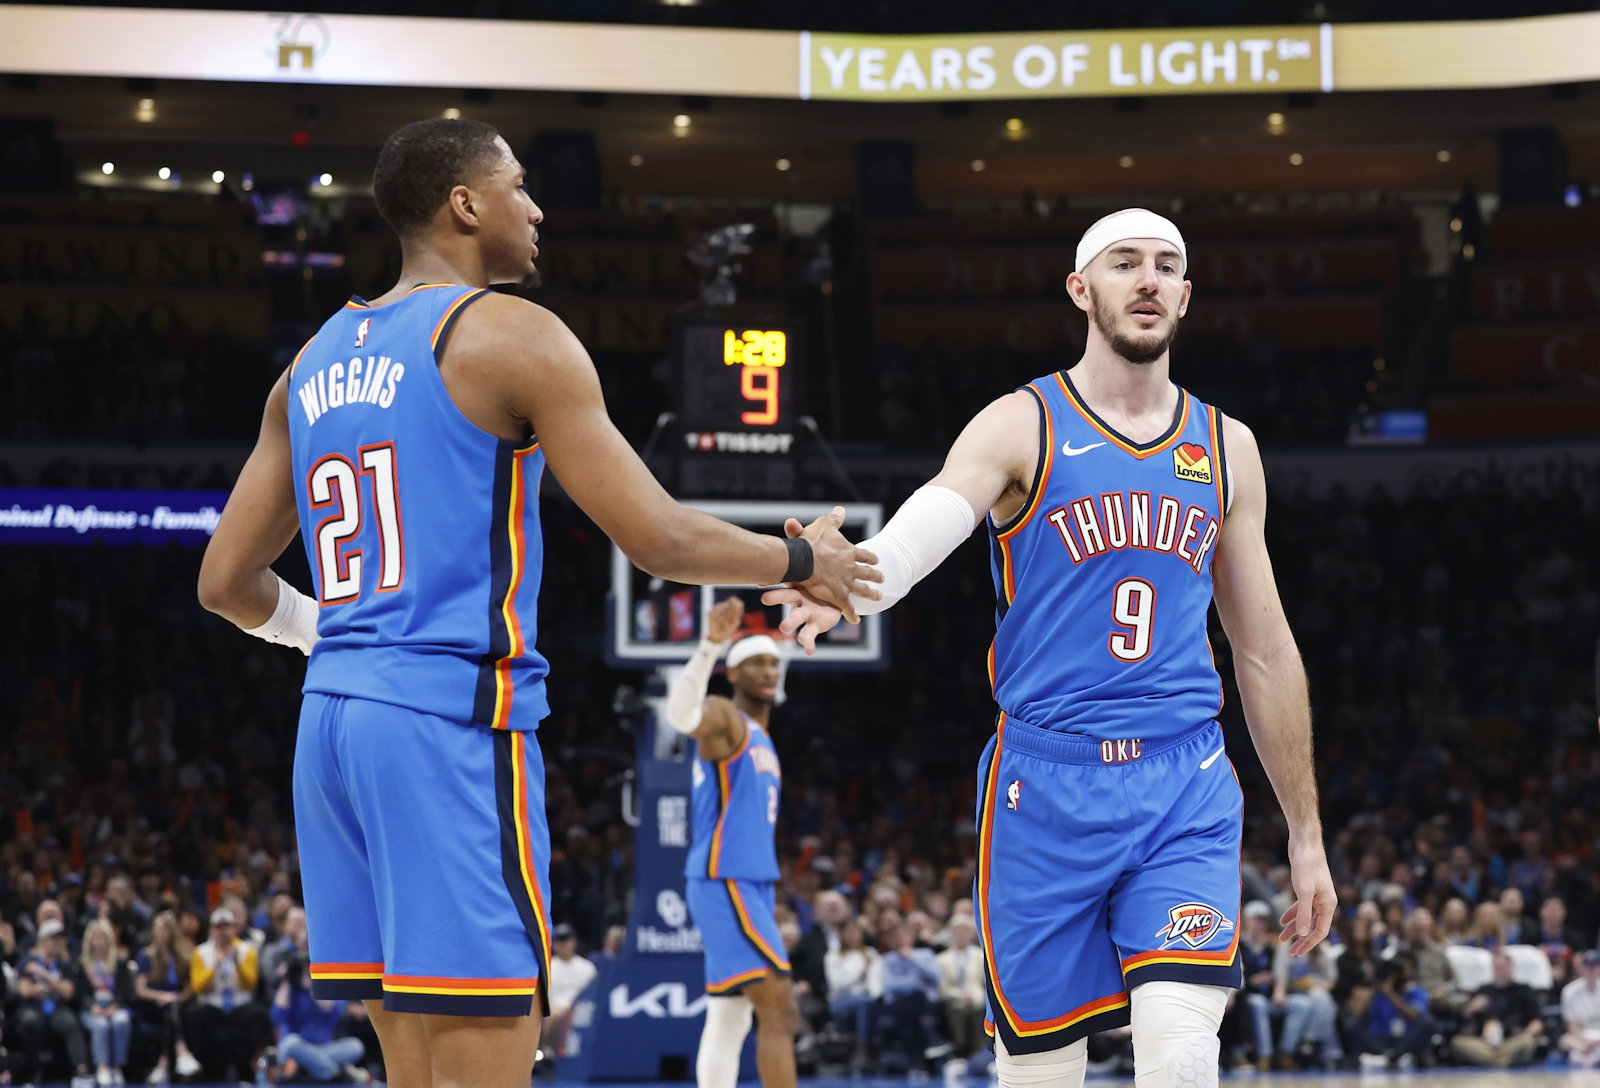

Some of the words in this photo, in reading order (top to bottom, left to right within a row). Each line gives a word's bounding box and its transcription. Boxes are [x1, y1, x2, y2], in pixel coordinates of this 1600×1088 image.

[819, 46, 998, 92] YEARS
[1011, 43, 1091, 88] OF
[724, 329, 786, 367] 1:28
[298, 356, 405, 427] WIGGINS
[740, 365, 779, 426] 9
[54, 504, 137, 534] Defense
[306, 440, 405, 608] 21
[1046, 490, 1220, 576] THUNDER
[1108, 576, 1157, 663] 9
[1101, 738, 1143, 764] OKC
[1172, 912, 1213, 934] OKC
